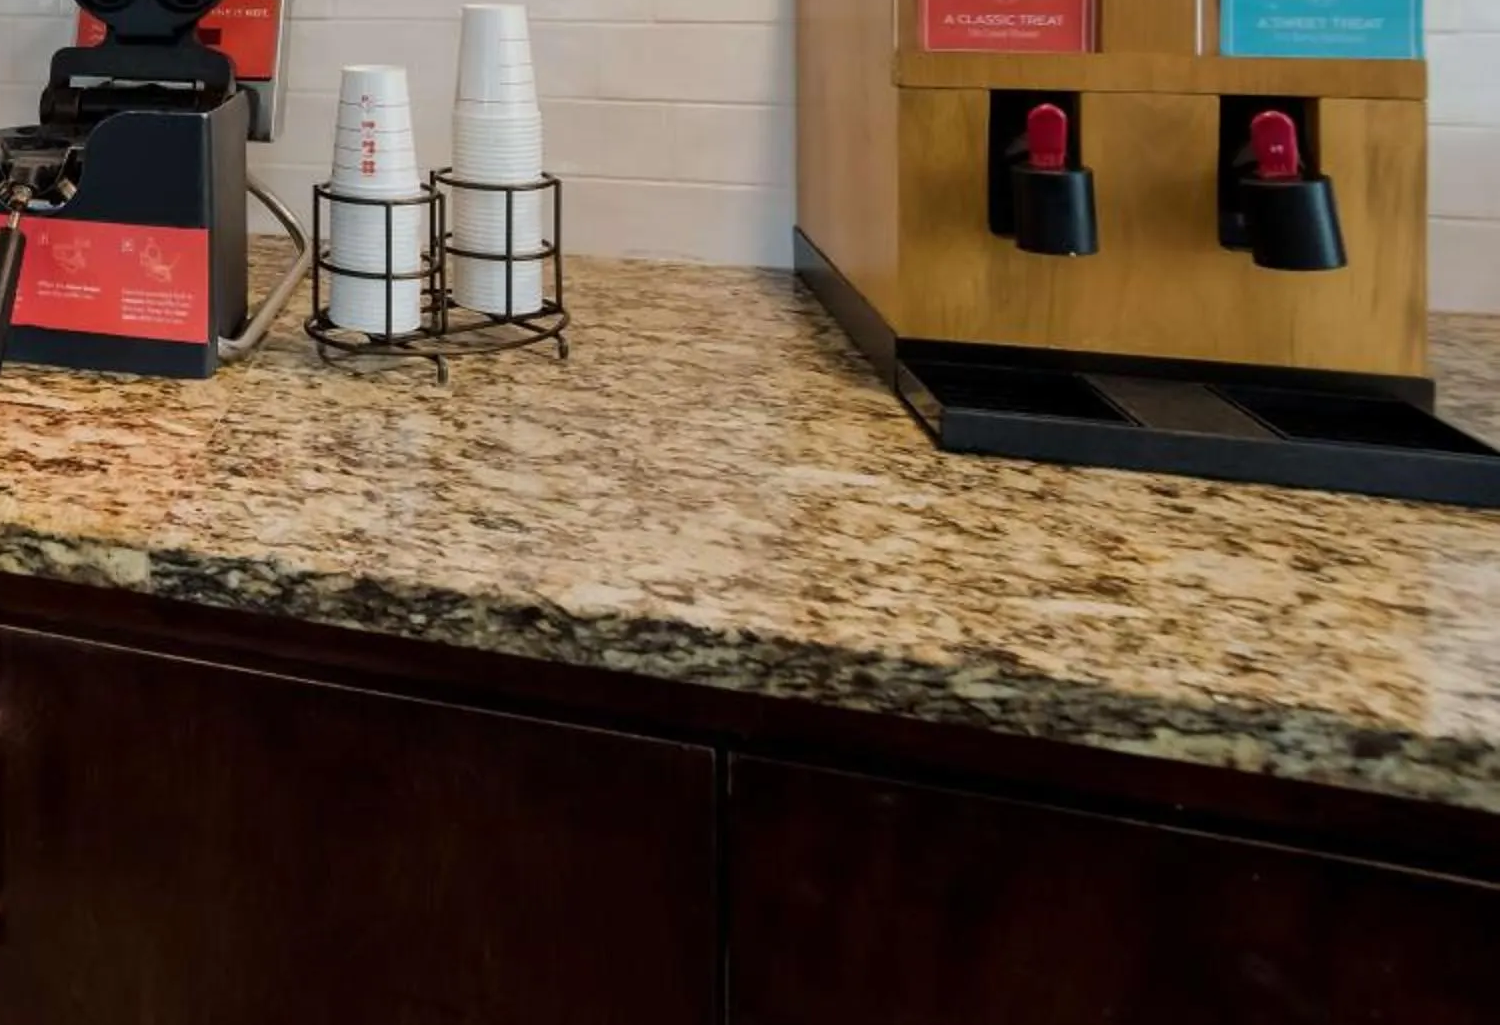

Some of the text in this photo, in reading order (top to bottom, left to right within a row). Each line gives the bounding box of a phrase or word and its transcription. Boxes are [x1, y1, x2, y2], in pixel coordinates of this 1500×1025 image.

[944, 15, 1064, 26] A CLASSIC TREAT
